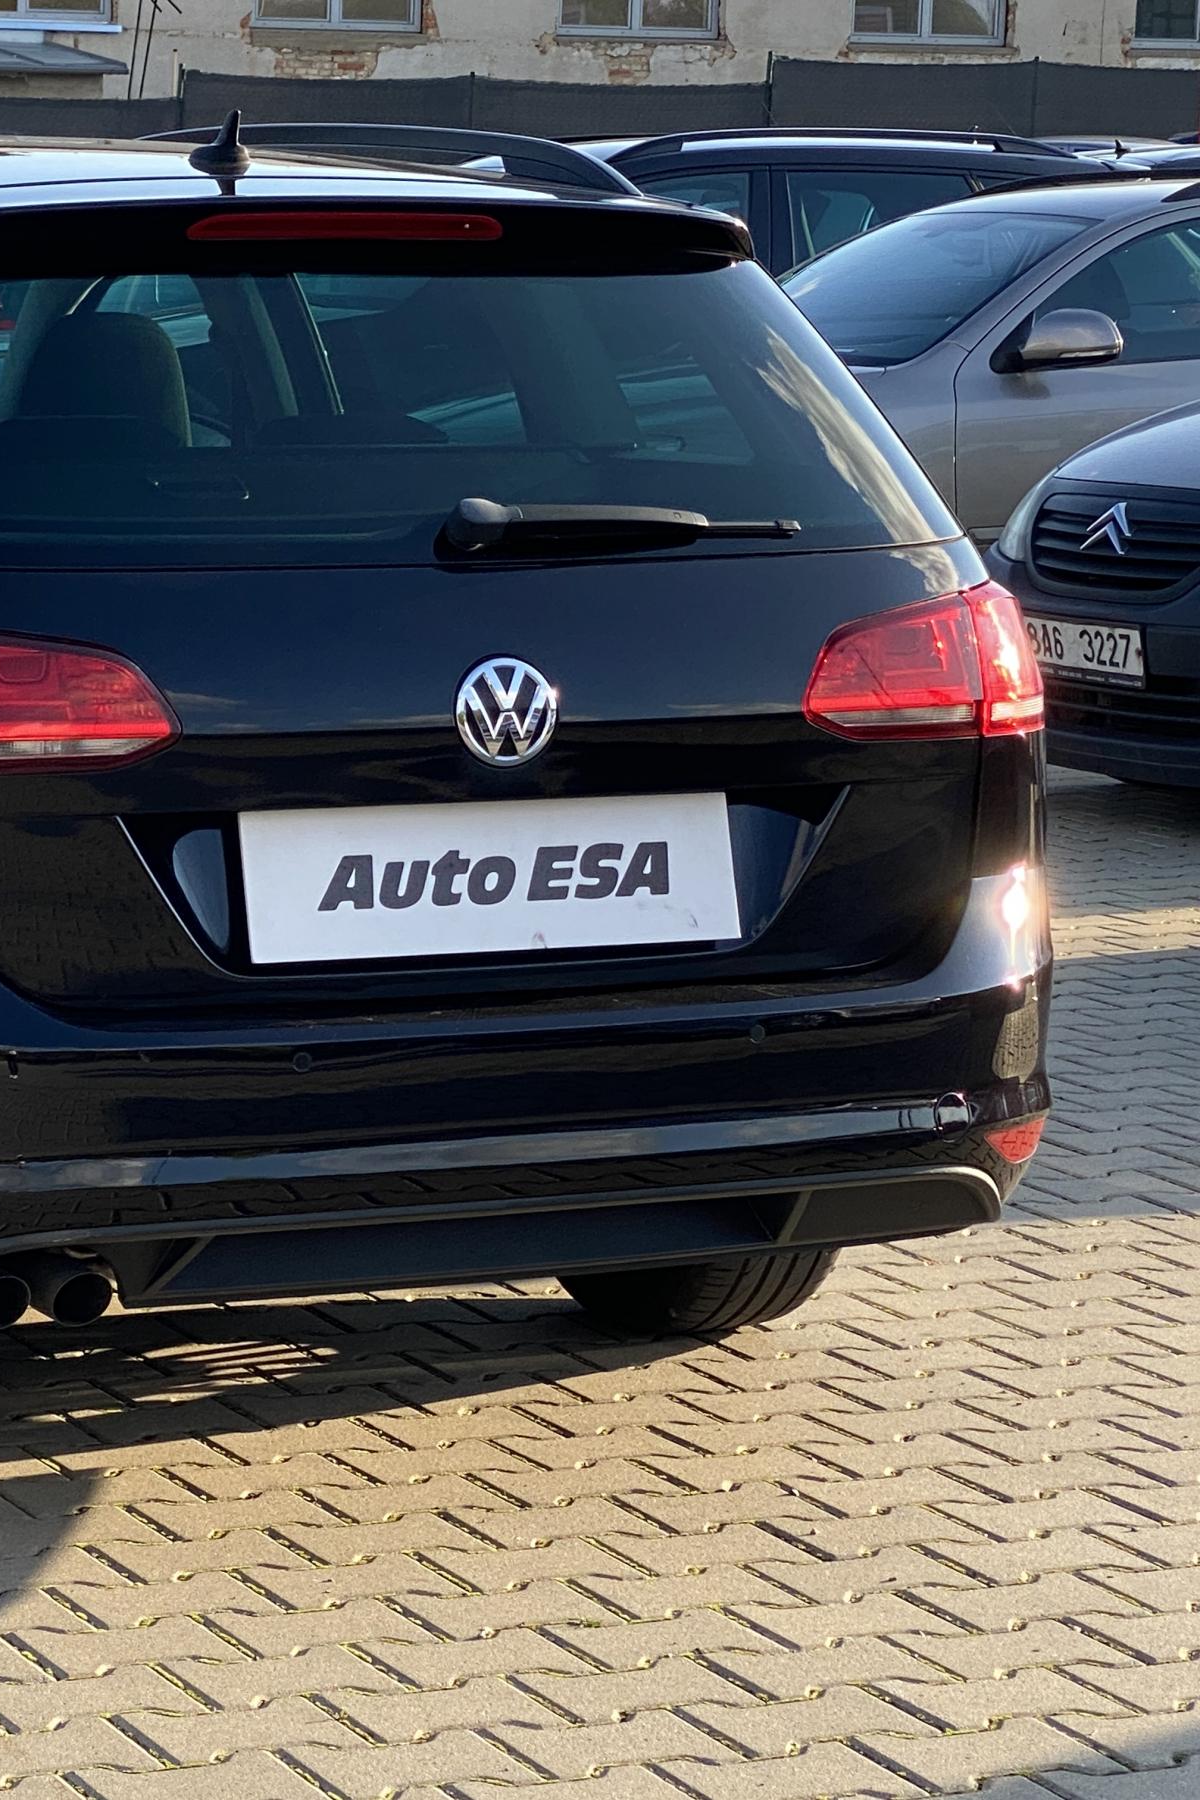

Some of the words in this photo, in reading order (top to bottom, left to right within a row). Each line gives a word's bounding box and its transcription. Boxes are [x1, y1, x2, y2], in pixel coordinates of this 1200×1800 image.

[1079, 629, 1131, 669] 3227
[317, 849, 517, 912] Auto
[526, 840, 670, 902] ESA
